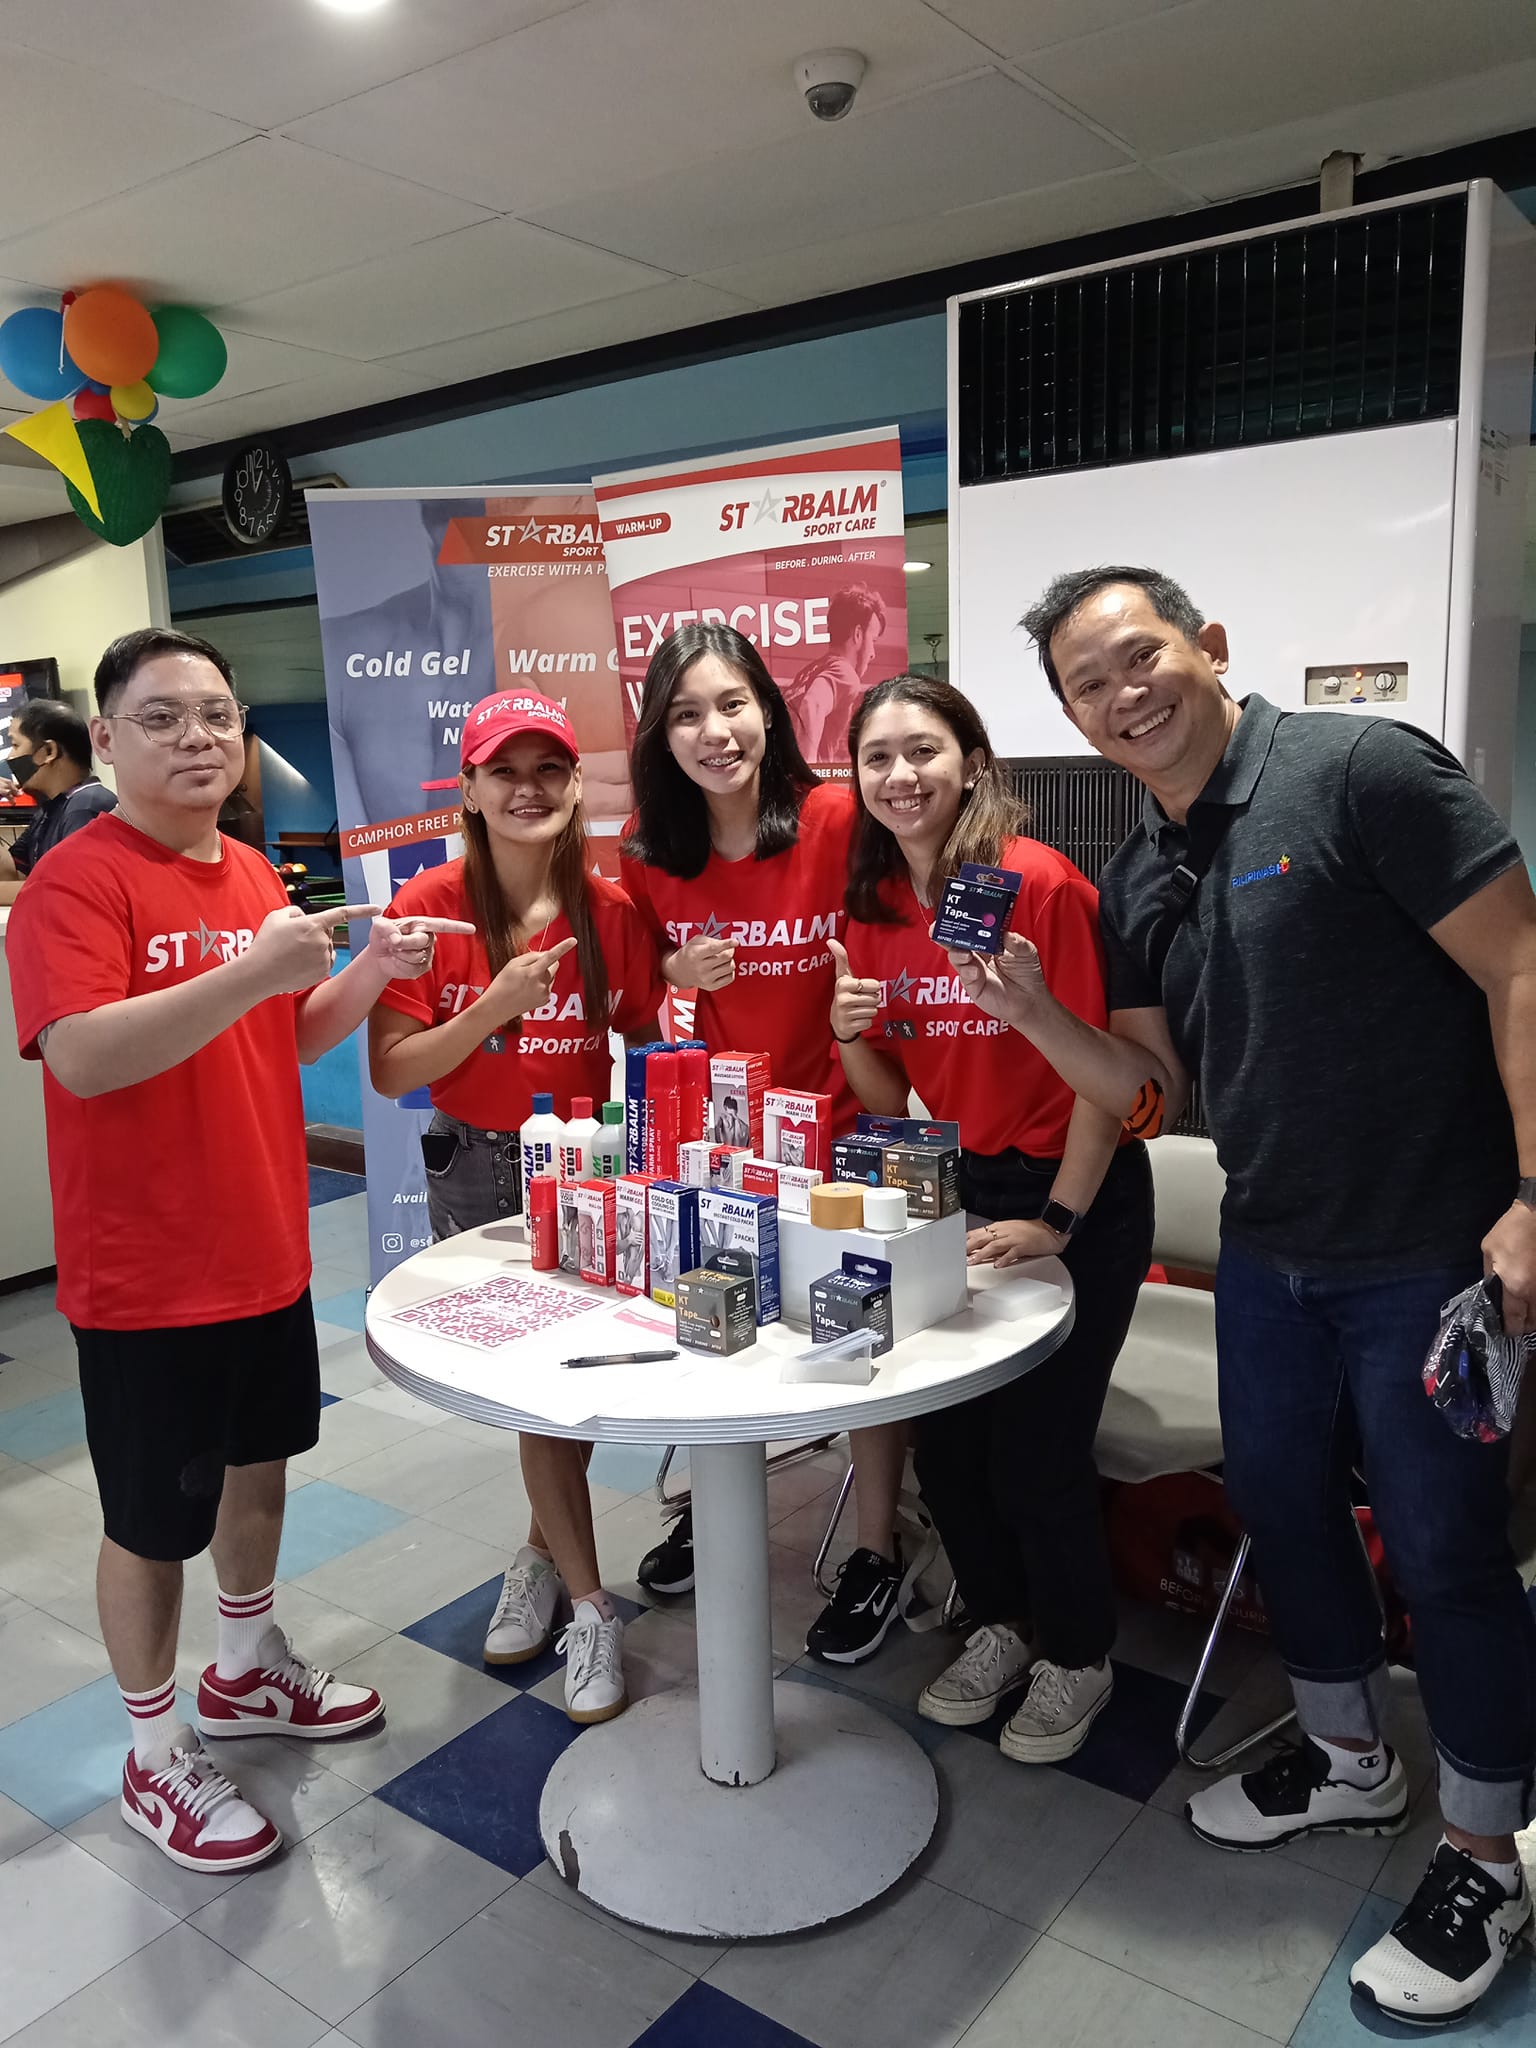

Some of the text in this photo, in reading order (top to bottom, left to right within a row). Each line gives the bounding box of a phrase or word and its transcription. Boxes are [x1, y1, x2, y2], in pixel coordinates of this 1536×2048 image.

[615, 519, 663, 536] WARM-UP
[803, 517, 876, 538] SPORT CARE
[562, 547, 599, 557] SPORT
[775, 551, 876, 570] BEFORE DURING AFTER
[488, 565, 545, 578] EXERCISE
[549, 564, 581, 577] WITH
[584, 564, 593, 576] A
[345, 649, 471, 678] Cold Gel
[509, 649, 596, 673] Warm
[348, 823, 413, 848] CAMPHOR
[417, 815, 448, 833] FREE
[947, 893, 961, 904] KT
[945, 905, 969, 919] Tape
[738, 961, 793, 976] SPORT
[517, 1034, 605, 1054] SPORT CA
[836, 1157, 847, 1166] KT
[836, 1168, 856, 1179] Tape
[887, 1165, 898, 1174] KT
[887, 1176, 908, 1188] Tape
[651, 1194, 665, 1203] COLD
[738, 1234, 755, 1243] PACKS
[679, 1295, 689, 1305] KT
[679, 1307, 698, 1319] Tape
[815, 1302, 826, 1313] KT
[815, 1314, 836, 1328] Tape
